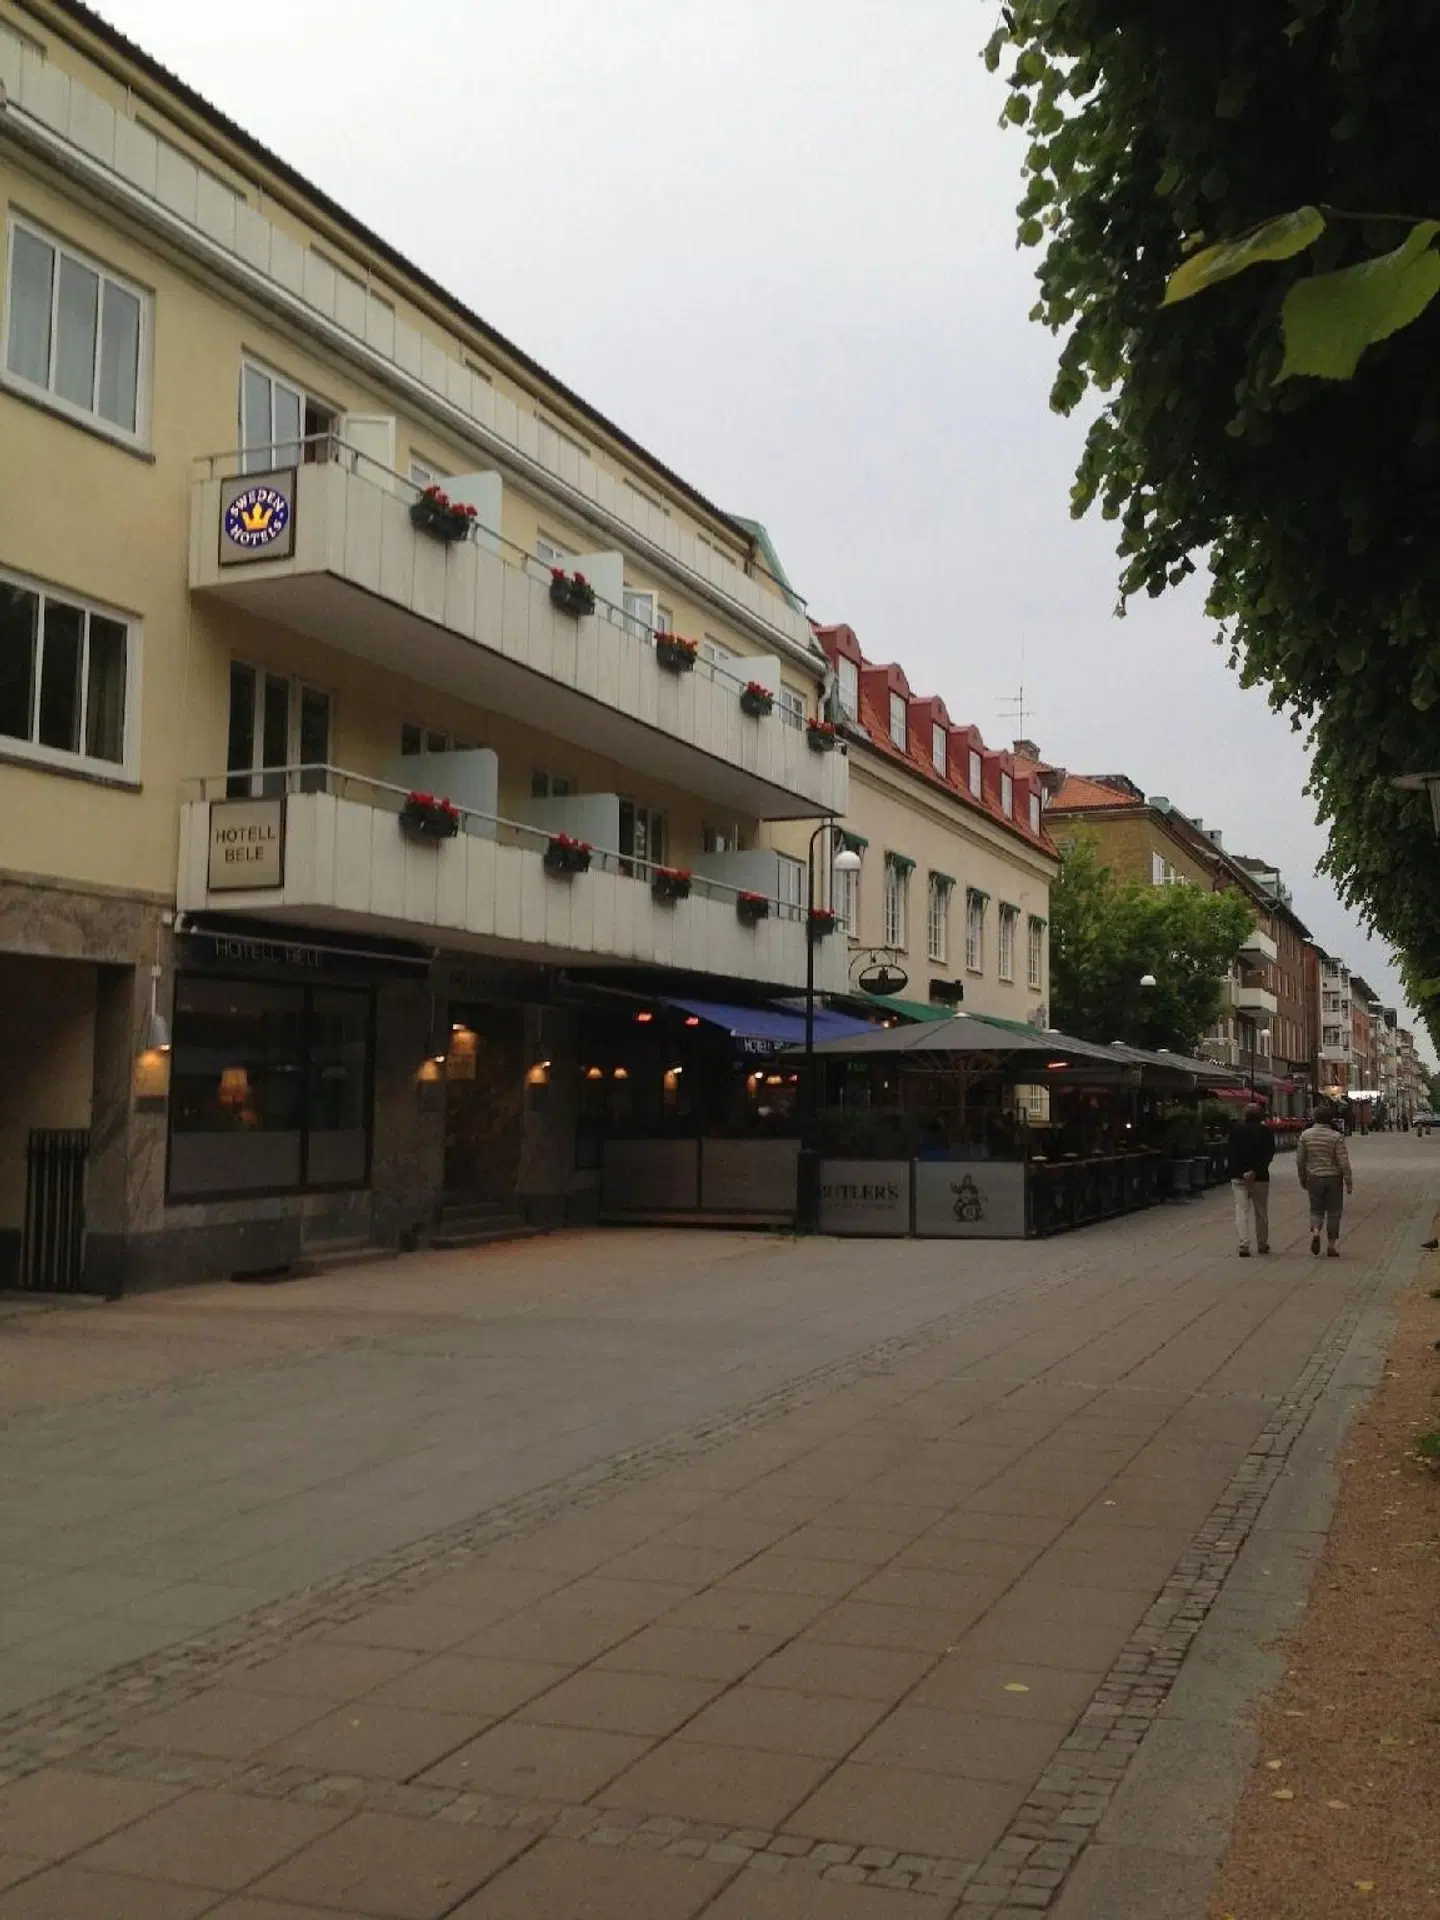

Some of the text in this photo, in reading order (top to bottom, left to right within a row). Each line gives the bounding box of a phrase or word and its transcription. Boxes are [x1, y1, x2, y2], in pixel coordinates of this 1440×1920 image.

[230, 489, 285, 518] SWEDEN
[230, 518, 283, 546] HOTELS
[216, 825, 276, 844] HOTELL
[225, 846, 264, 864] BELE
